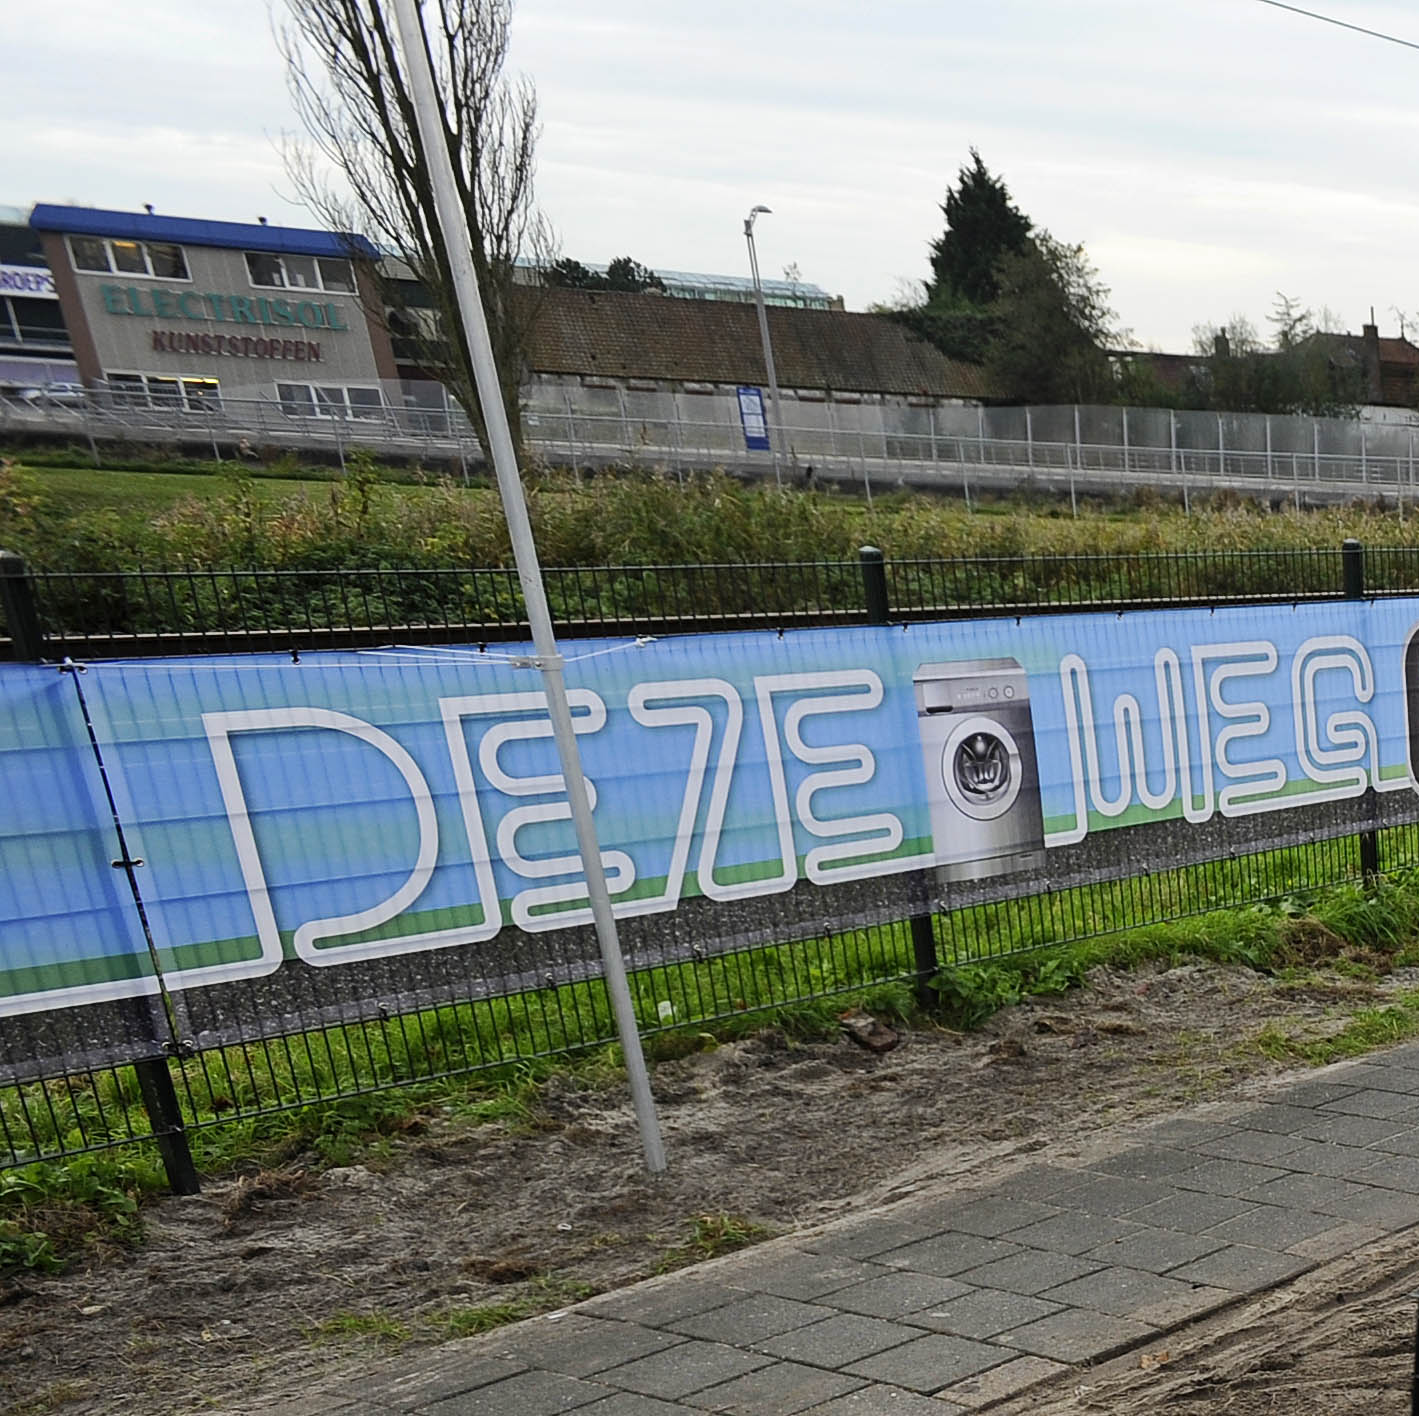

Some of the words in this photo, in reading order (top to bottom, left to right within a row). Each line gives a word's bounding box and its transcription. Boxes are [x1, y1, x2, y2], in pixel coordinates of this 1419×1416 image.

[101, 284, 348, 331] ELECTRISOL
[152, 330, 324, 361] KUNSTSTOFFEN
[1048, 634, 1378, 848] WEG
